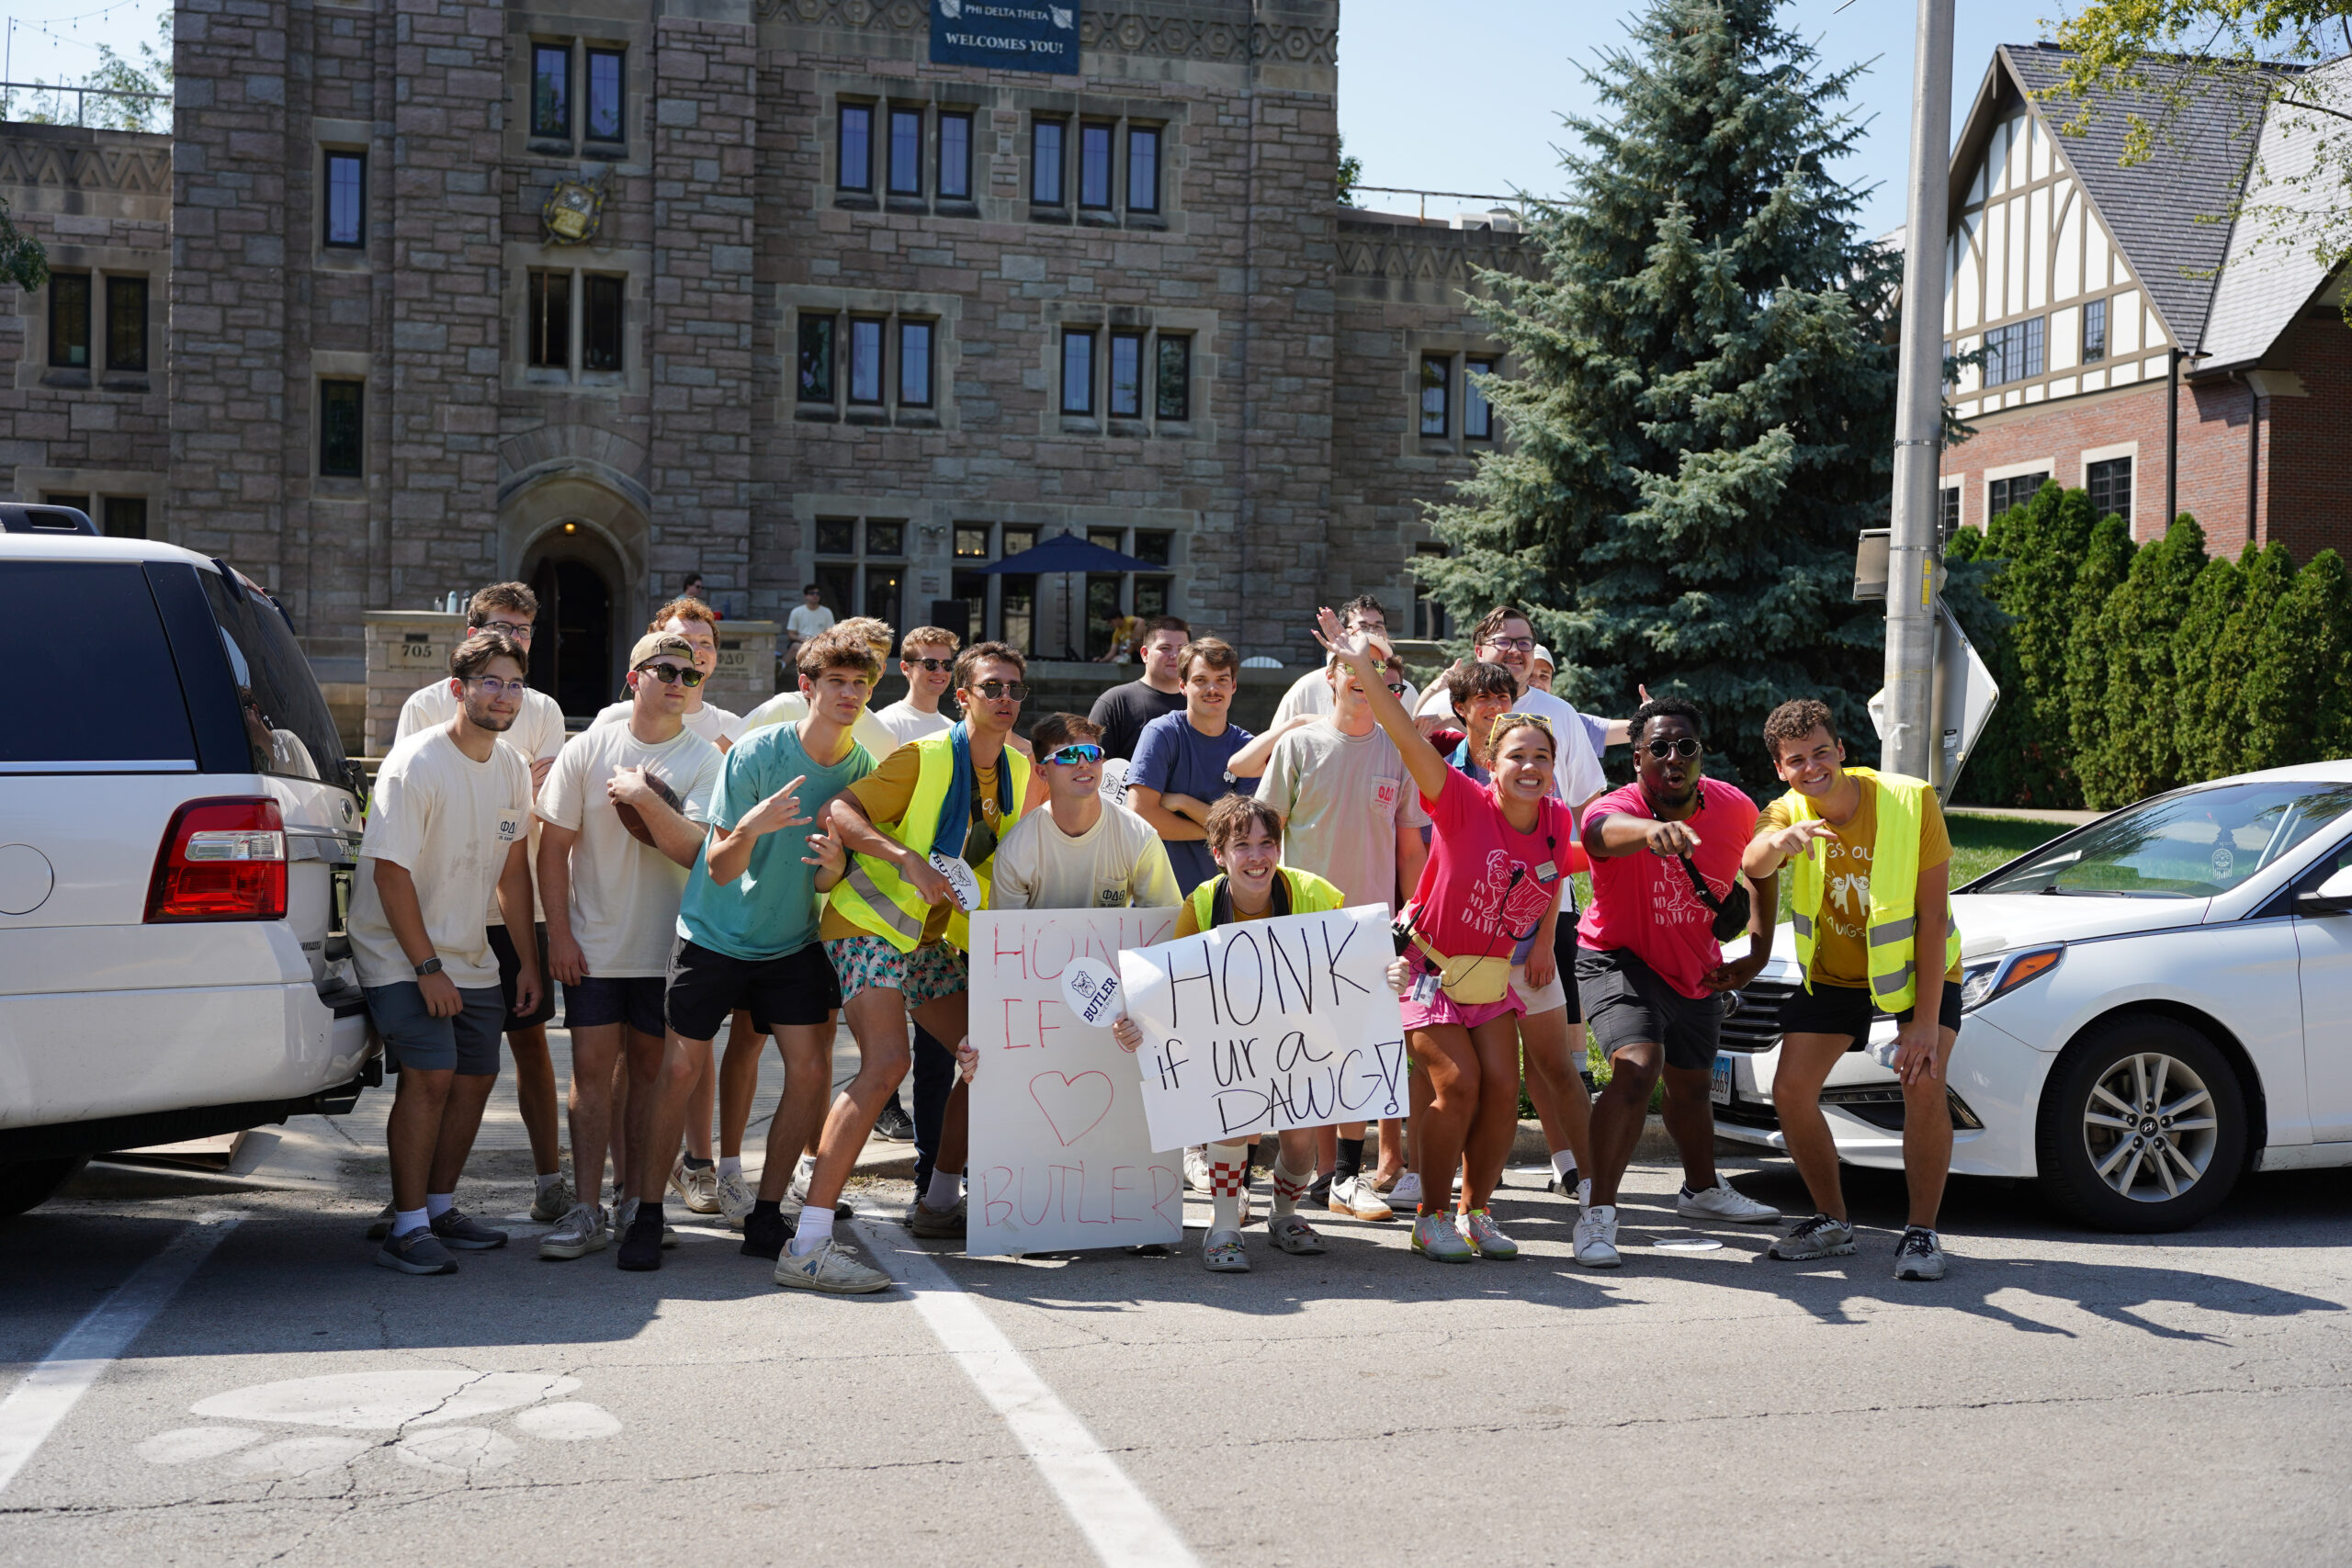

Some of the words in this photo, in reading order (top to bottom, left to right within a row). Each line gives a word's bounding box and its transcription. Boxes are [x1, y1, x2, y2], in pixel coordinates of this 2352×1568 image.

[965, 5, 982, 15] PHI
[985, 6, 1016, 18] DELTA
[1017, 8, 1049, 21] THETA
[945, 32, 1026, 51] WELCOMES
[1029, 39, 1064, 54] YOU!
[401, 645, 432, 658] 705
[1473, 879, 1488, 896] IN
[1654, 881, 1667, 893] IN
[1468, 892, 1487, 910] MY
[1653, 896, 1670, 909] MY
[1460, 908, 1507, 938] DAWG
[1654, 909, 1697, 928] DAWG
[1167, 919, 1371, 1029] HONK
[1083, 976, 1118, 1023] BUTLER
[1096, 990, 1118, 1021] UNIVERSITY
[1002, 998, 1062, 1050] IF
[1154, 1038, 1190, 1091] if
[1212, 1037, 1260, 1088] ur
[1275, 1031, 1334, 1073] a
[1211, 1038, 1404, 1135] DAWG!
[979, 1160, 1182, 1236] BUTLER
